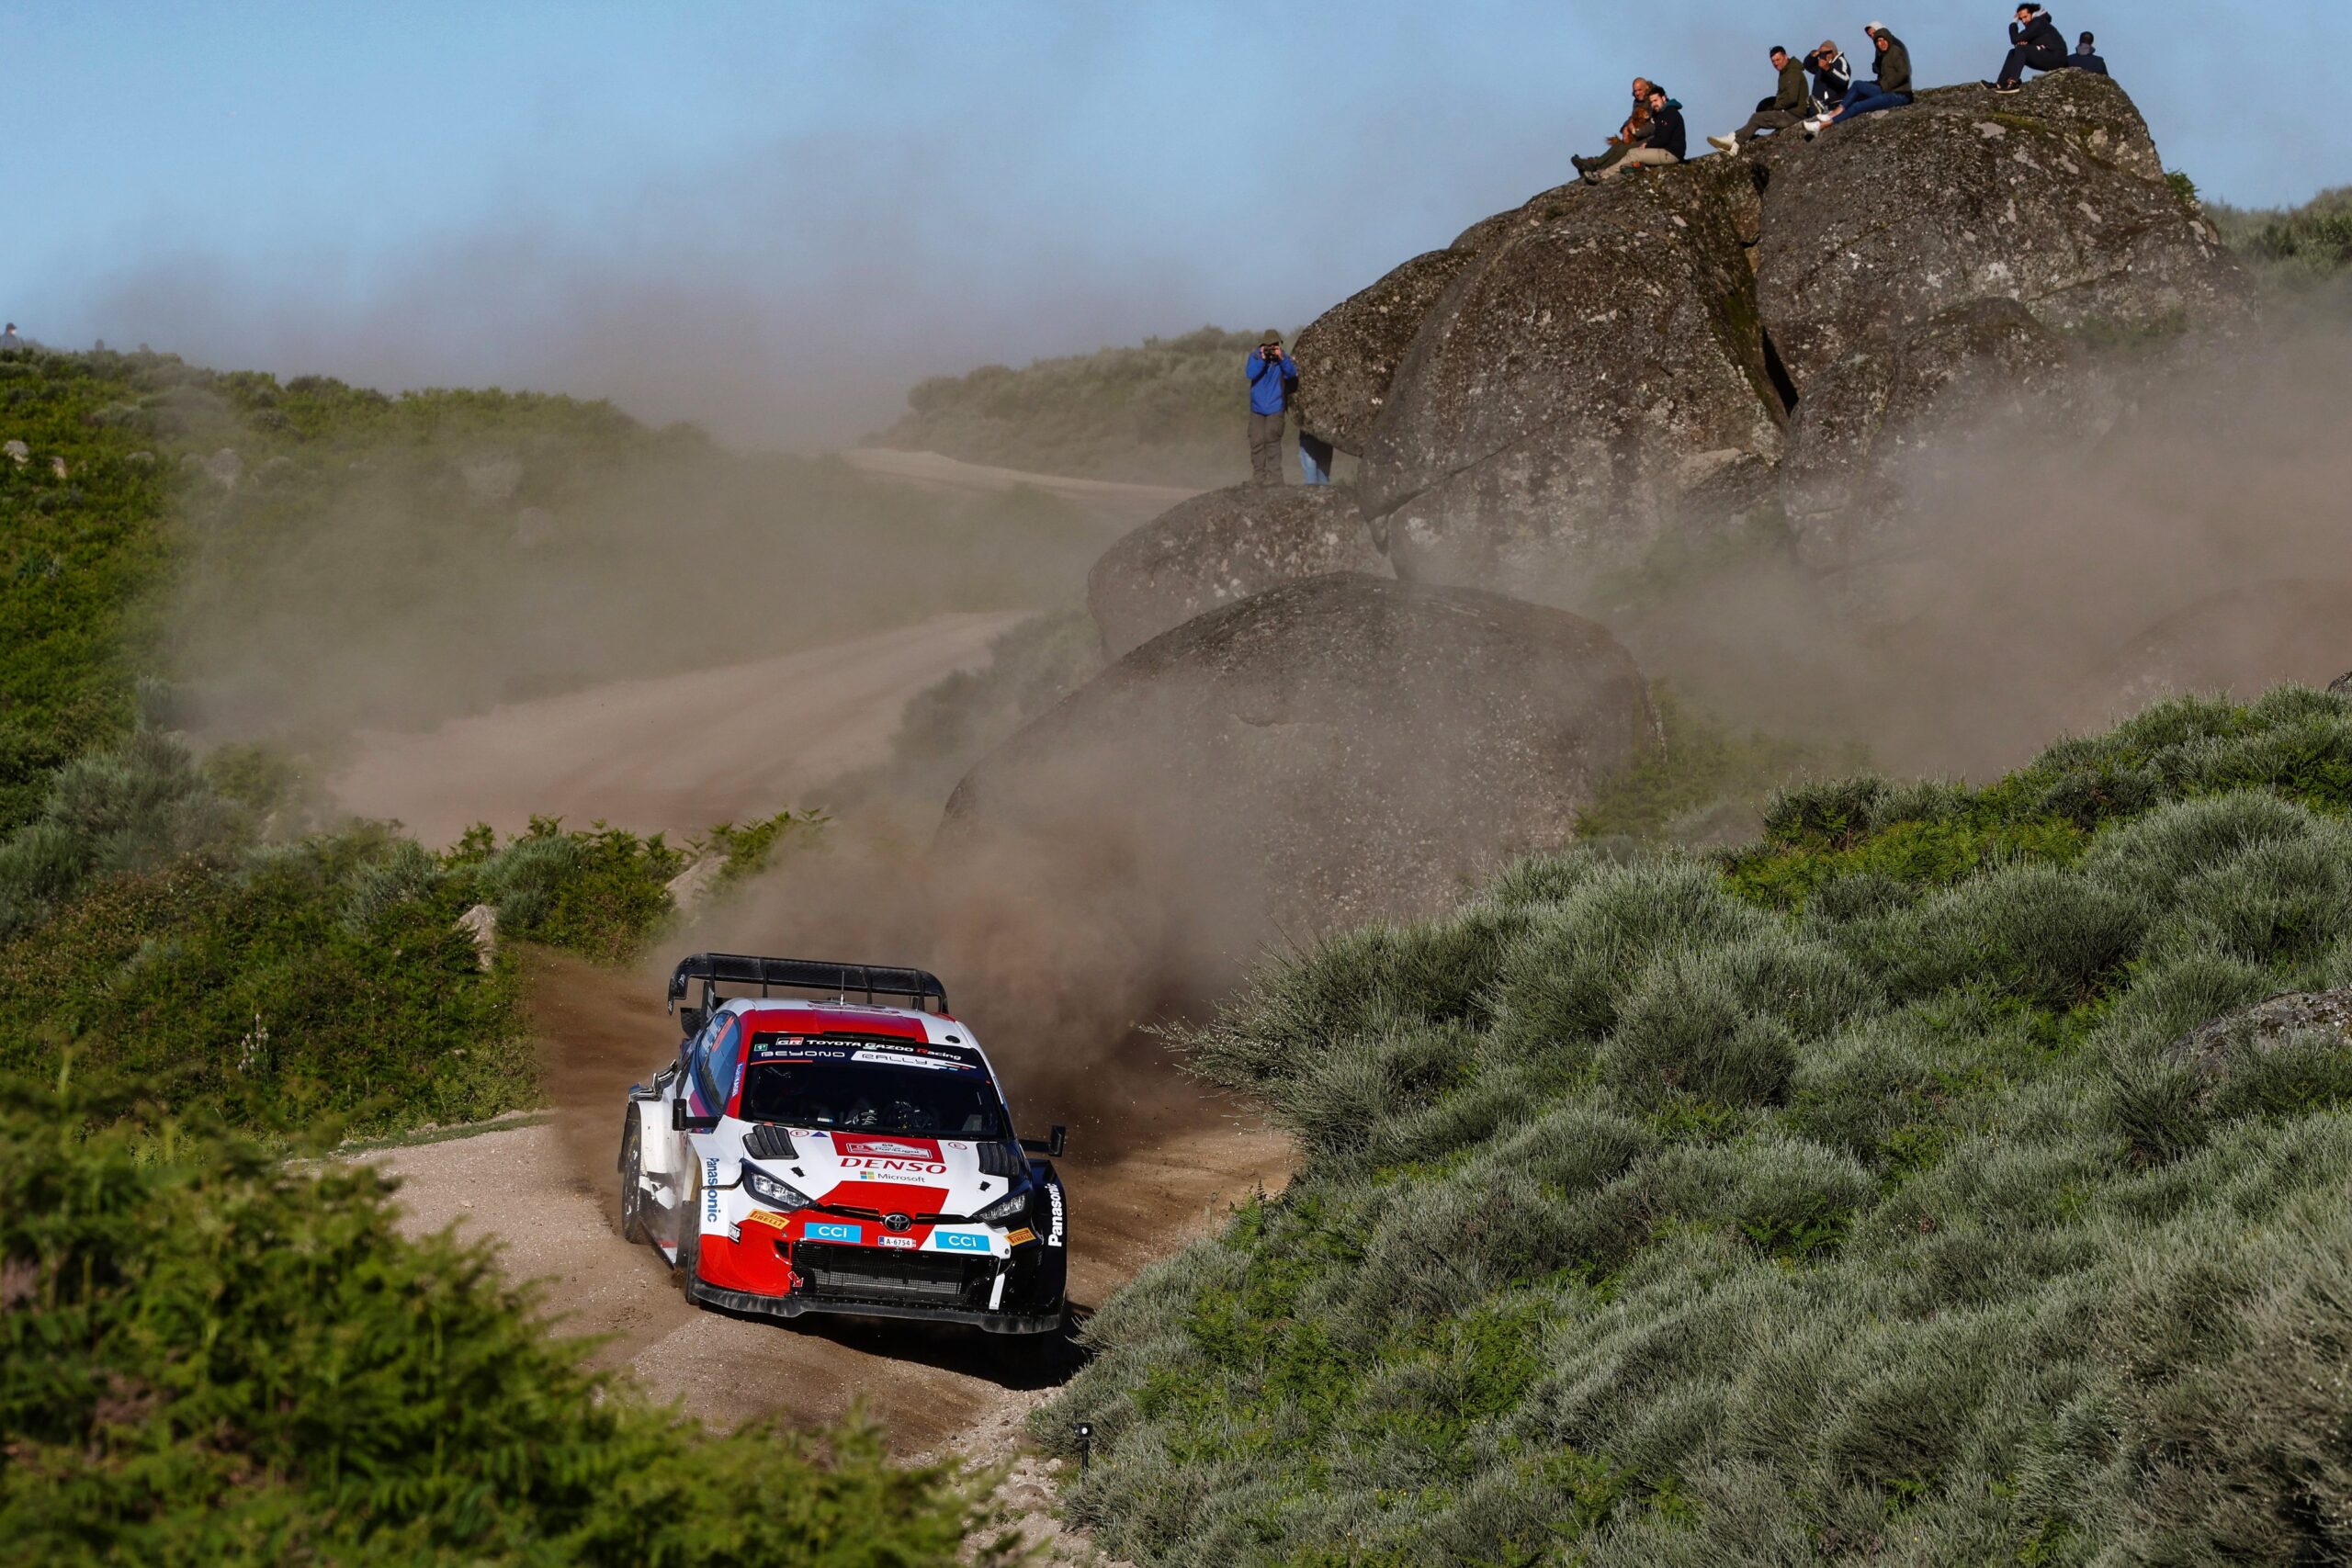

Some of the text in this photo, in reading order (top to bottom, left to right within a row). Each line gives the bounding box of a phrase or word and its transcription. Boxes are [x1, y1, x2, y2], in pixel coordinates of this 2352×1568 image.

[807, 1039, 861, 1047] TOYOTA
[863, 1043, 914, 1052] GAZOO
[917, 1048, 961, 1060] Racing
[861, 1054, 928, 1066] RALLY
[841, 1157, 947, 1175] DENSO
[877, 1173, 925, 1183] Microsoft
[707, 1157, 721, 1223] Panasonic
[750, 1211, 786, 1227] PIRELLI
[1045, 1183, 1063, 1247] Panasonic
